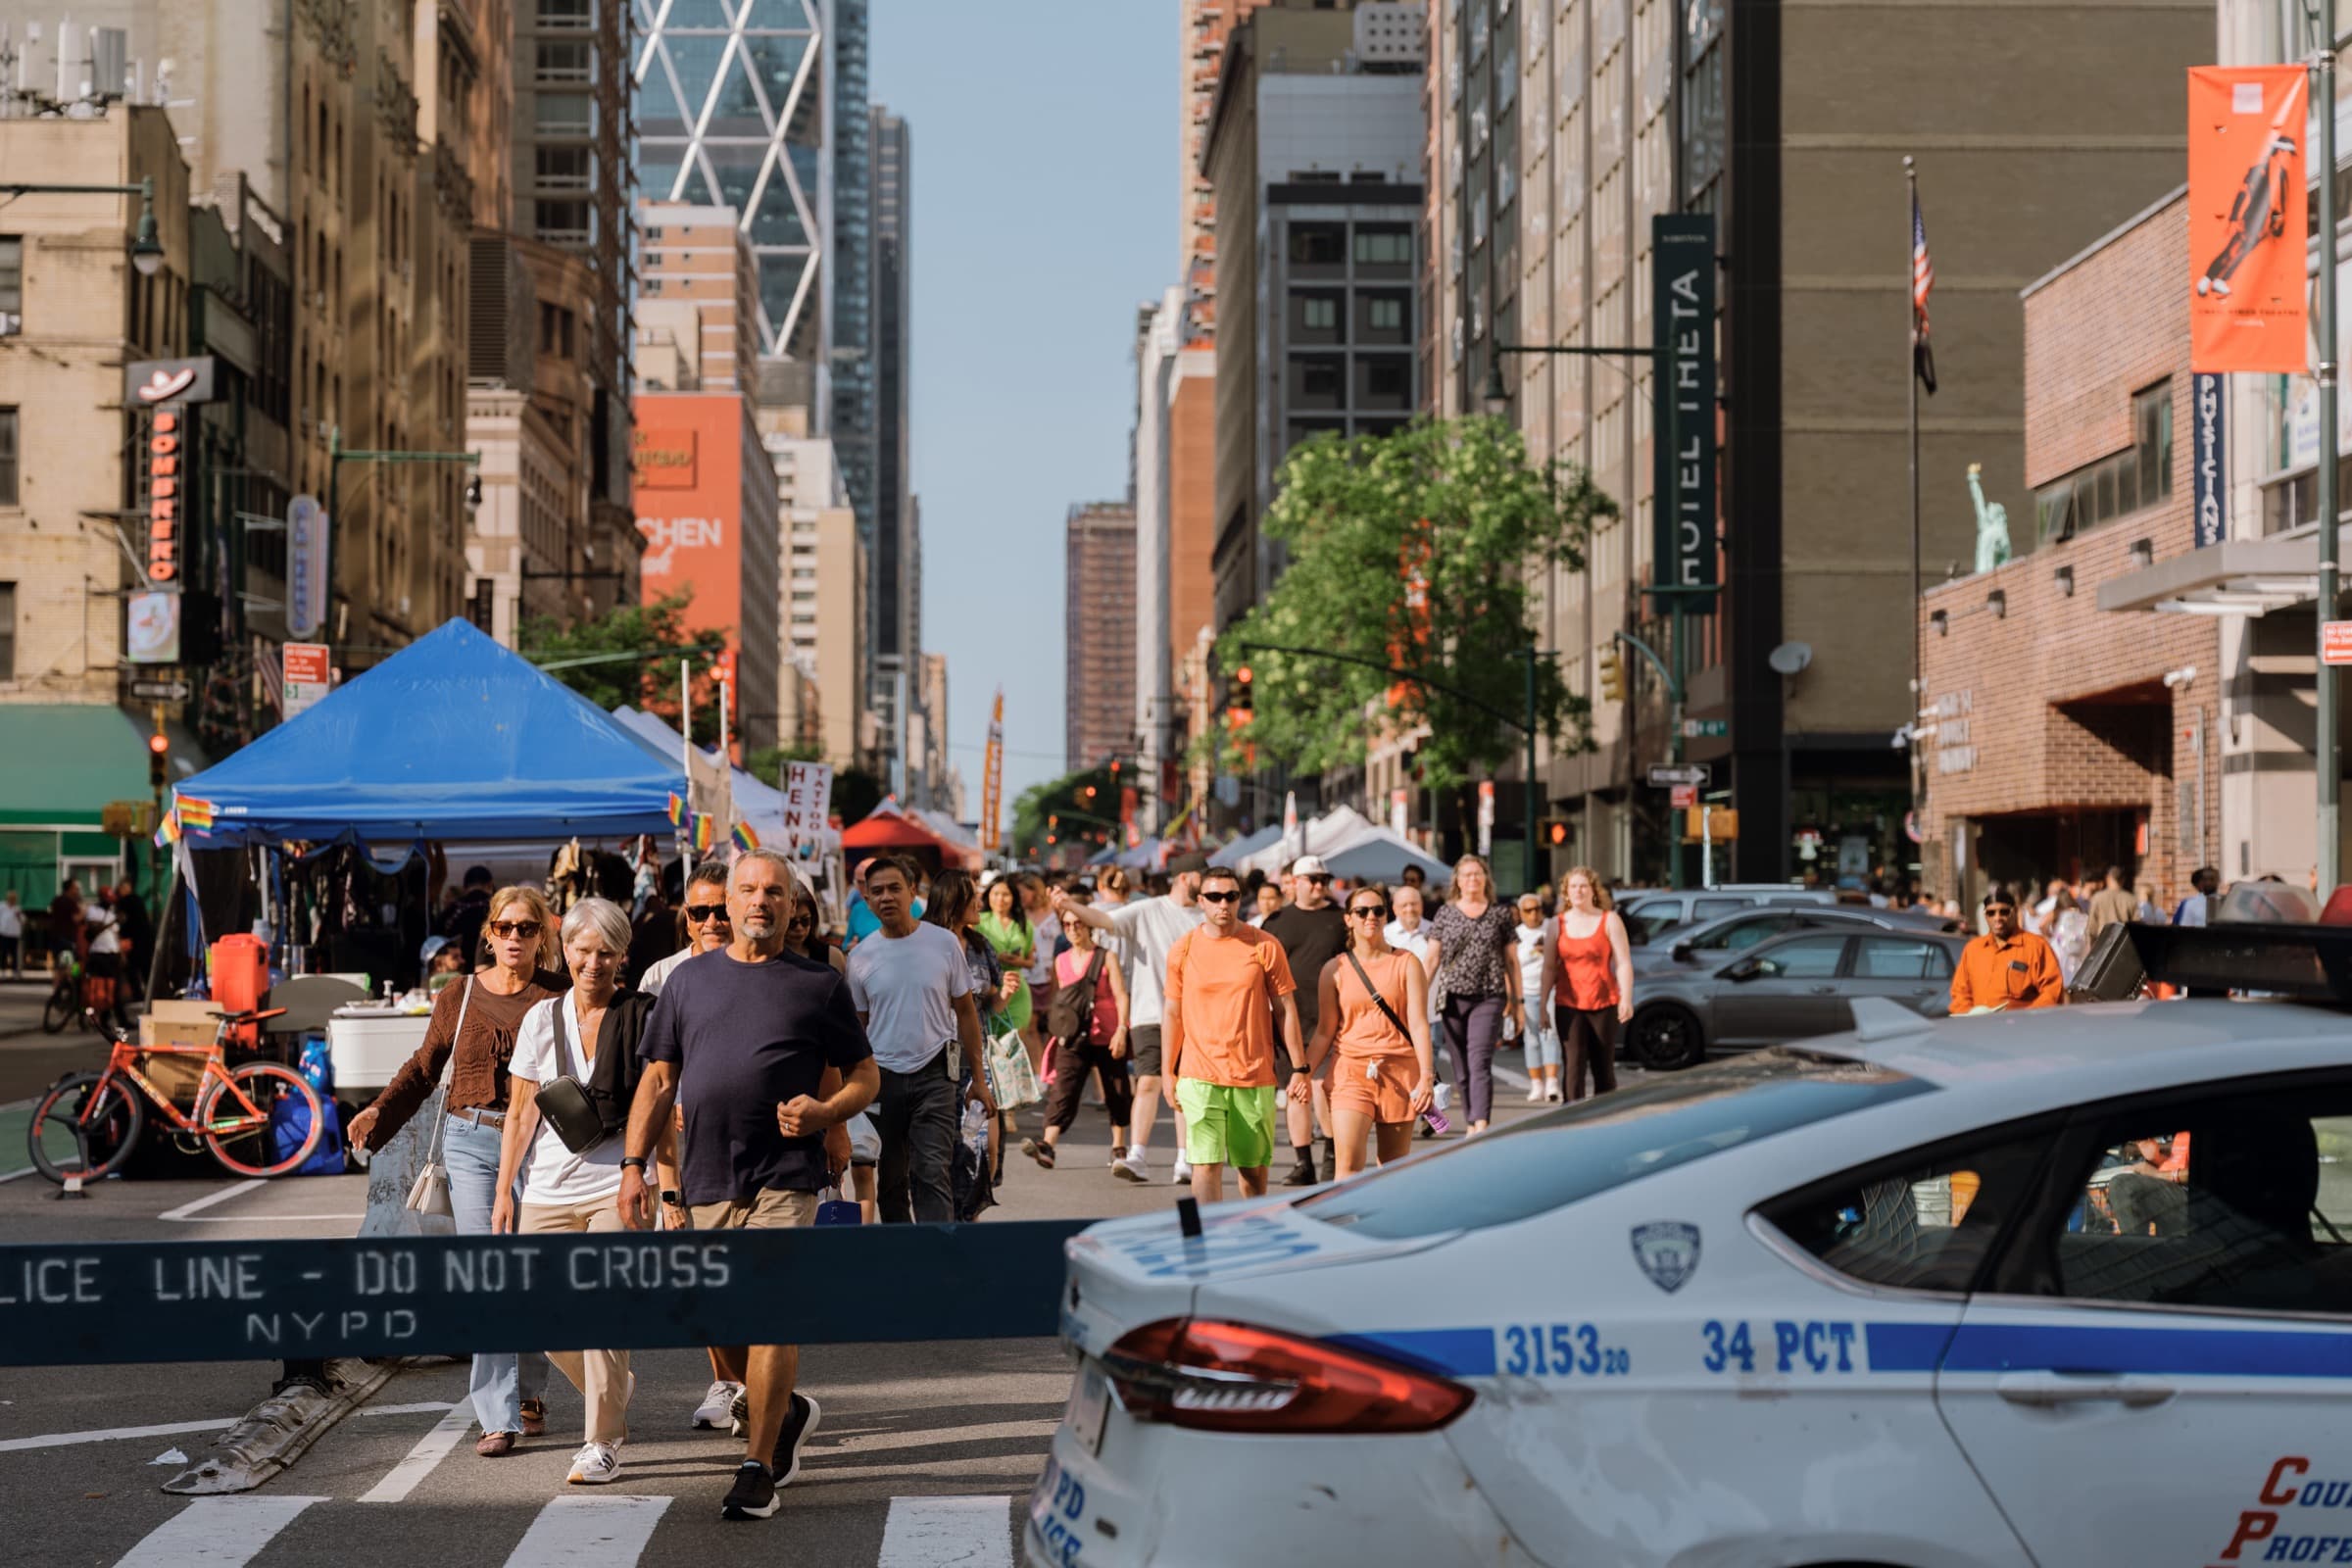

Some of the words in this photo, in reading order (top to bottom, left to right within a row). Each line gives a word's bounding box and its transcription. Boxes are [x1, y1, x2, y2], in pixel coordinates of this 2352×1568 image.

[2199, 374, 2220, 545] PHYSICIANS
[808, 767, 825, 831] TATTOO
[155, 1253, 265, 1301] LINE
[356, 1250, 417, 1296] DO
[444, 1247, 541, 1293] NOT
[568, 1244, 731, 1291] CROSS
[246, 1309, 417, 1344] NYPD
[1503, 1323, 1602, 1377] 3153
[1602, 1348, 1631, 1376] 20
[1701, 1319, 1756, 1373] 34
[1774, 1320, 1856, 1373] PCT
[2258, 1455, 2352, 1507] COU
